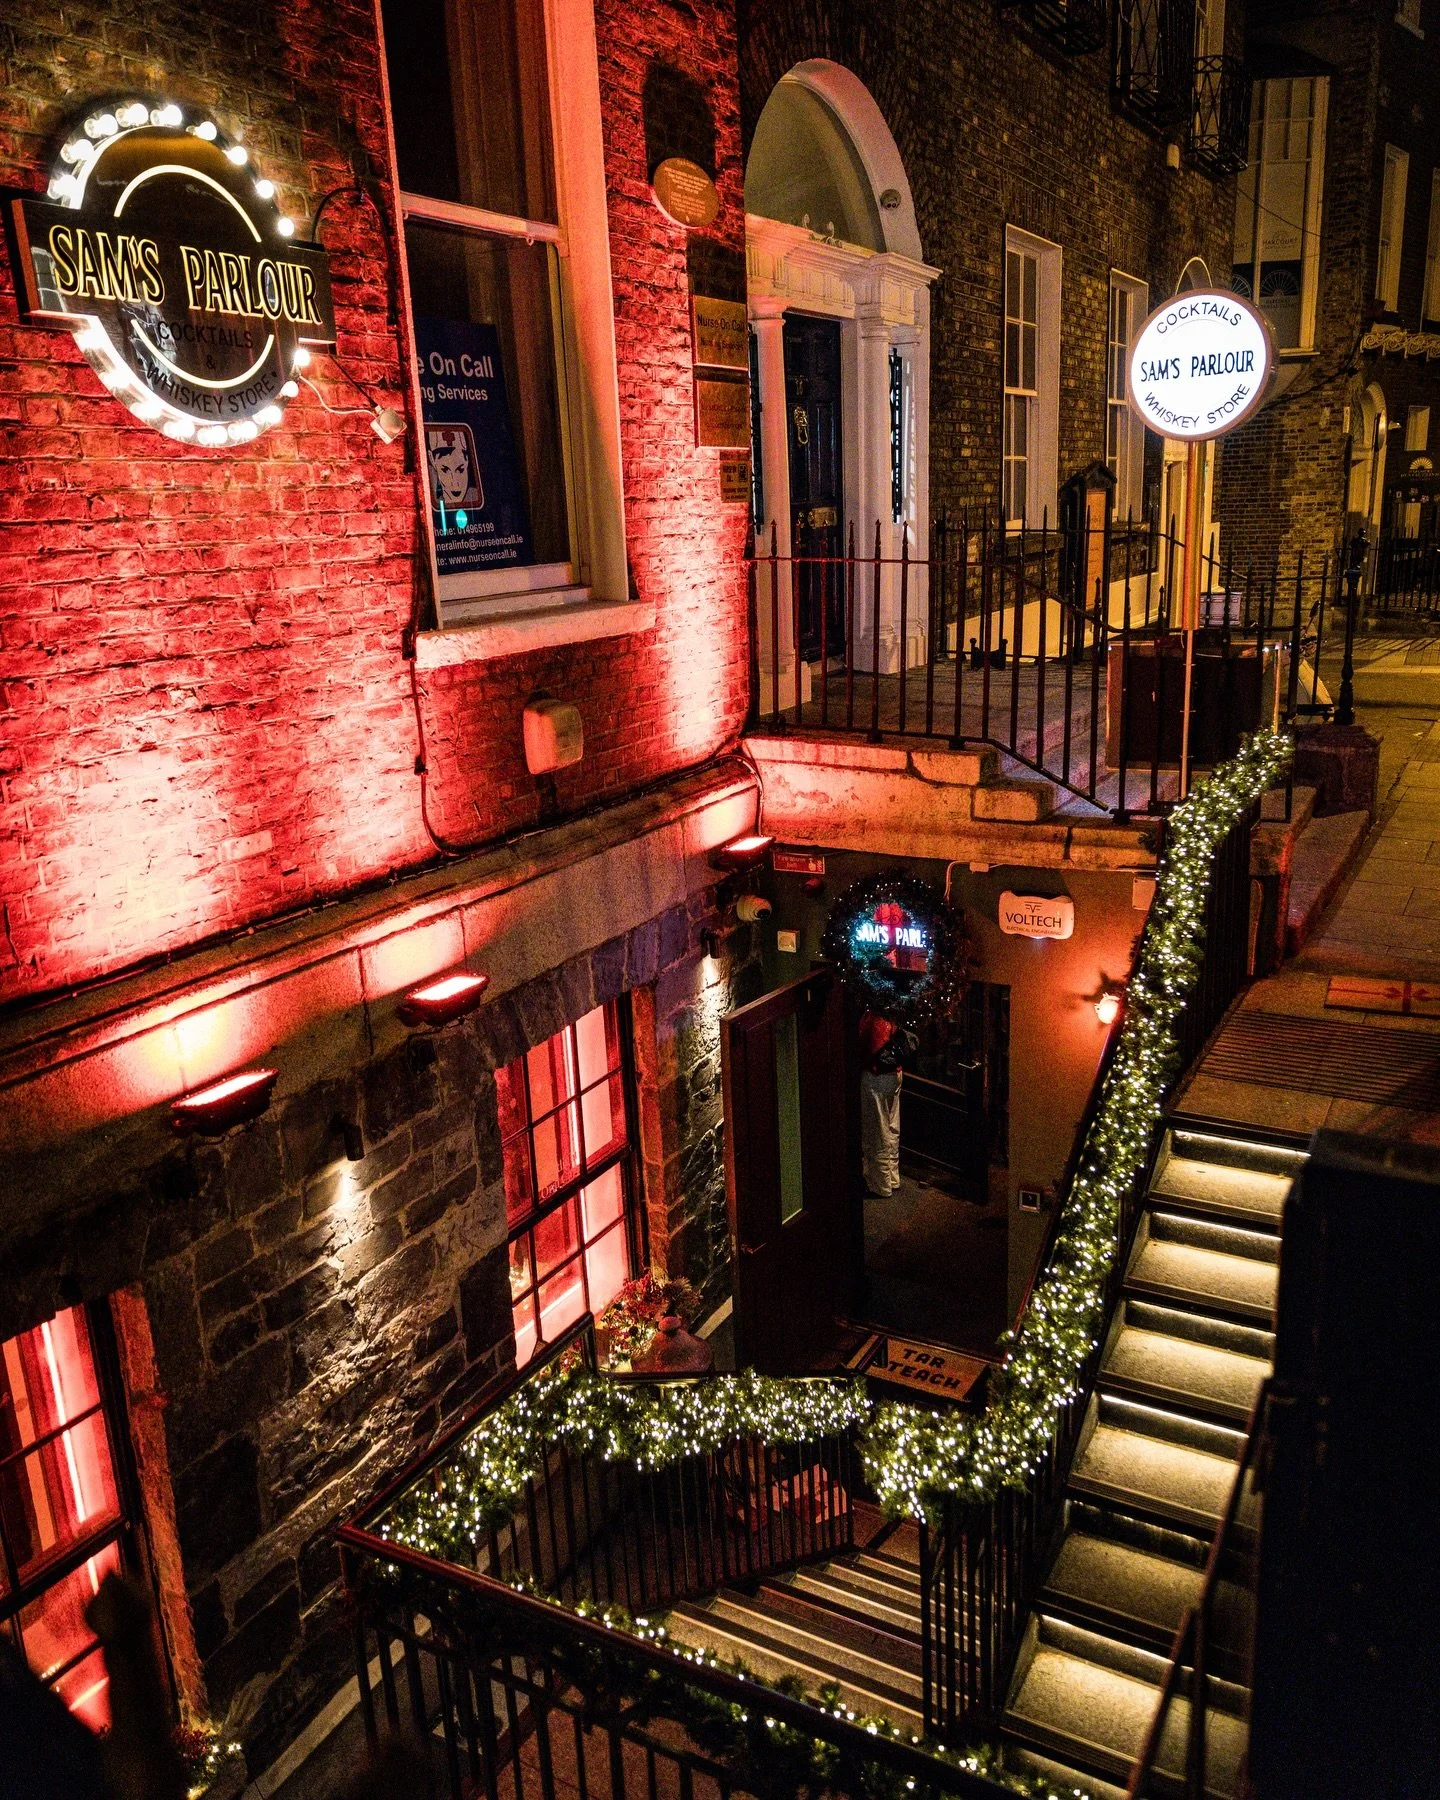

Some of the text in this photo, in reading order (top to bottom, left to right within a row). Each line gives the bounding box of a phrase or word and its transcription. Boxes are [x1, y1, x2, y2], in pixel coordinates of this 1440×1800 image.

[49, 225, 323, 325] SAM'S PARLOUR
[697, 313, 745, 333] Nurse On Call
[1156, 302, 1242, 334] COCKTAILS
[157, 320, 254, 349] COCKTAILS
[206, 354, 216, 370] &
[429, 351, 456, 376] On
[460, 354, 494, 378] Call
[1140, 350, 1254, 382] SAM'S PARLOUR
[146, 363, 276, 414] WHISKEY STORE
[437, 383, 488, 401] Services
[1145, 383, 1250, 428] WHISKEY STORE
[448, 548, 517, 565] www.nurseoncall.ie
[1005, 912, 1062, 929] VOLTECH
[895, 927, 927, 948] PARL
[887, 1348, 961, 1390] TAR TEACH
